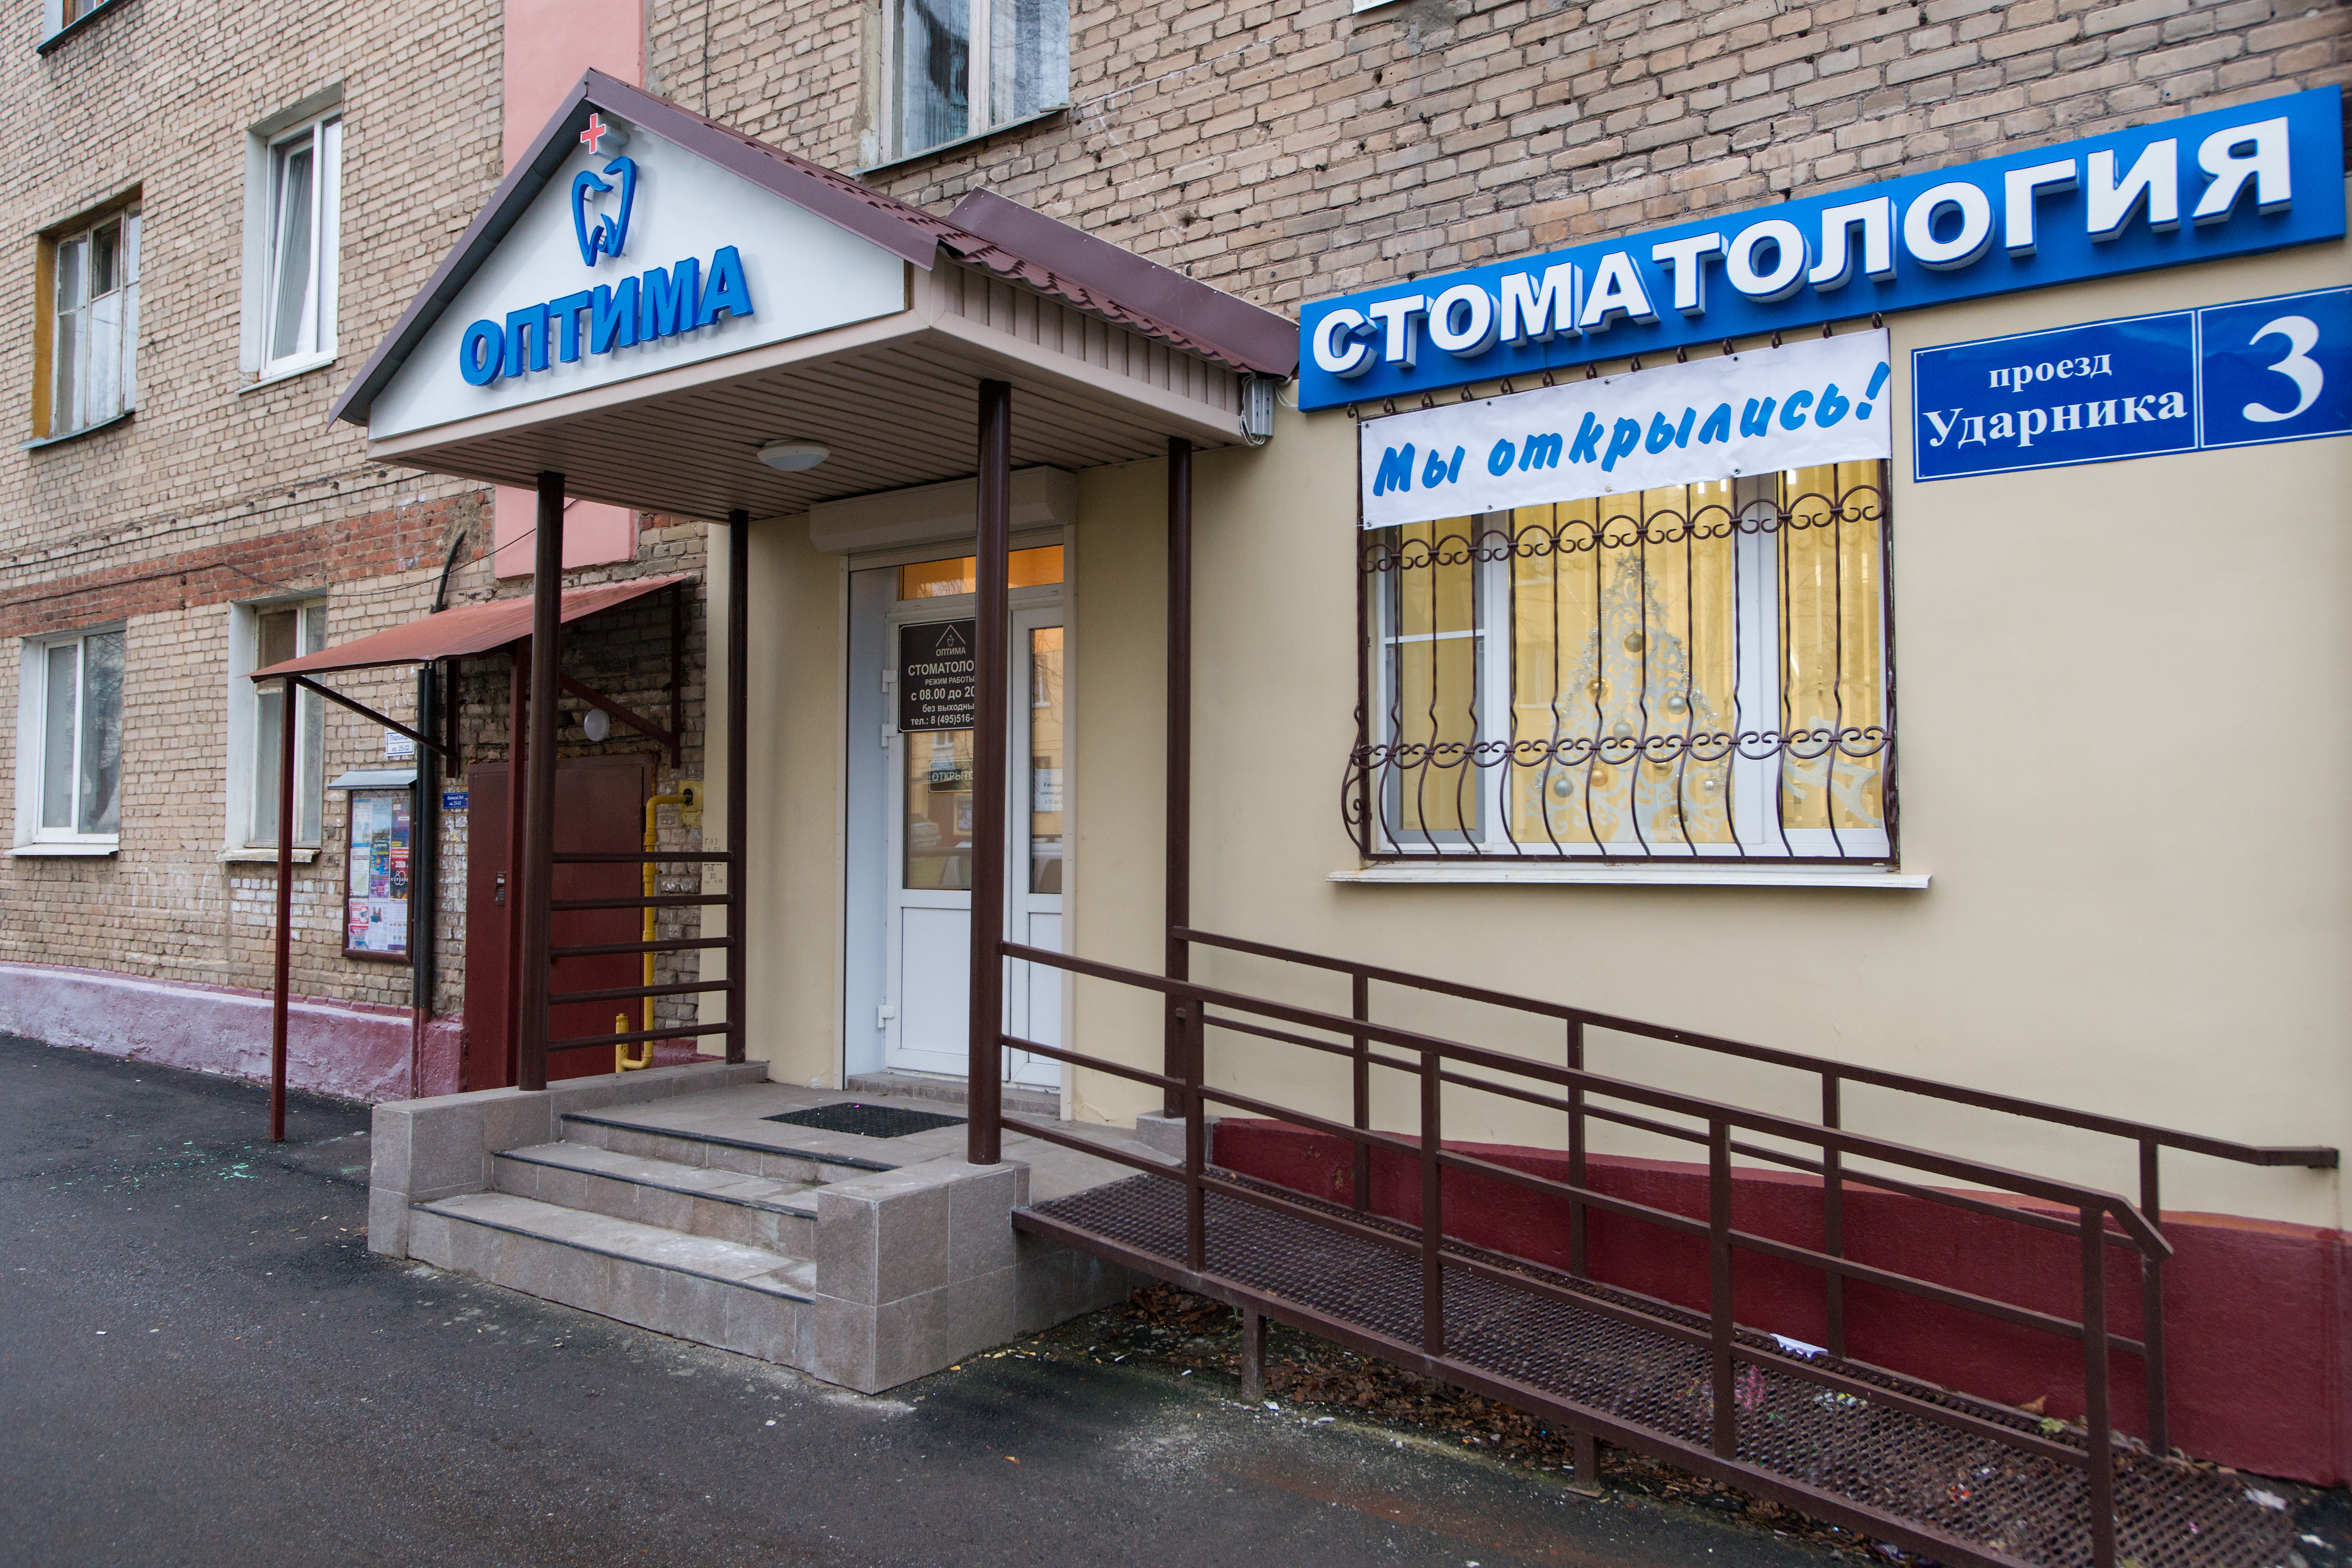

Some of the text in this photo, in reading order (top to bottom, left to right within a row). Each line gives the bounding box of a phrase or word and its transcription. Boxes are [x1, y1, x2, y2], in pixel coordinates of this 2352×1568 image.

[1313, 117, 2293, 374] СТОМАТОЛОГИЯ
[460, 244, 755, 387] ОПТИМА
[1989, 354, 2112, 393] проезд
[2242, 316, 2324, 422] 3
[1372, 361, 1891, 497] Мы открылись!
[1921, 391, 2187, 449] Ударника
[936, 647, 966, 656] ОПТИМА
[911, 692, 917, 701] с
[920, 688, 945, 700] 08.00
[948, 689, 962, 700] до
[949, 676, 975, 684] РАБОТЫ
[922, 704, 935, 713] без
[931, 716, 935, 724] 8
[937, 714, 974, 726] (495)516-
